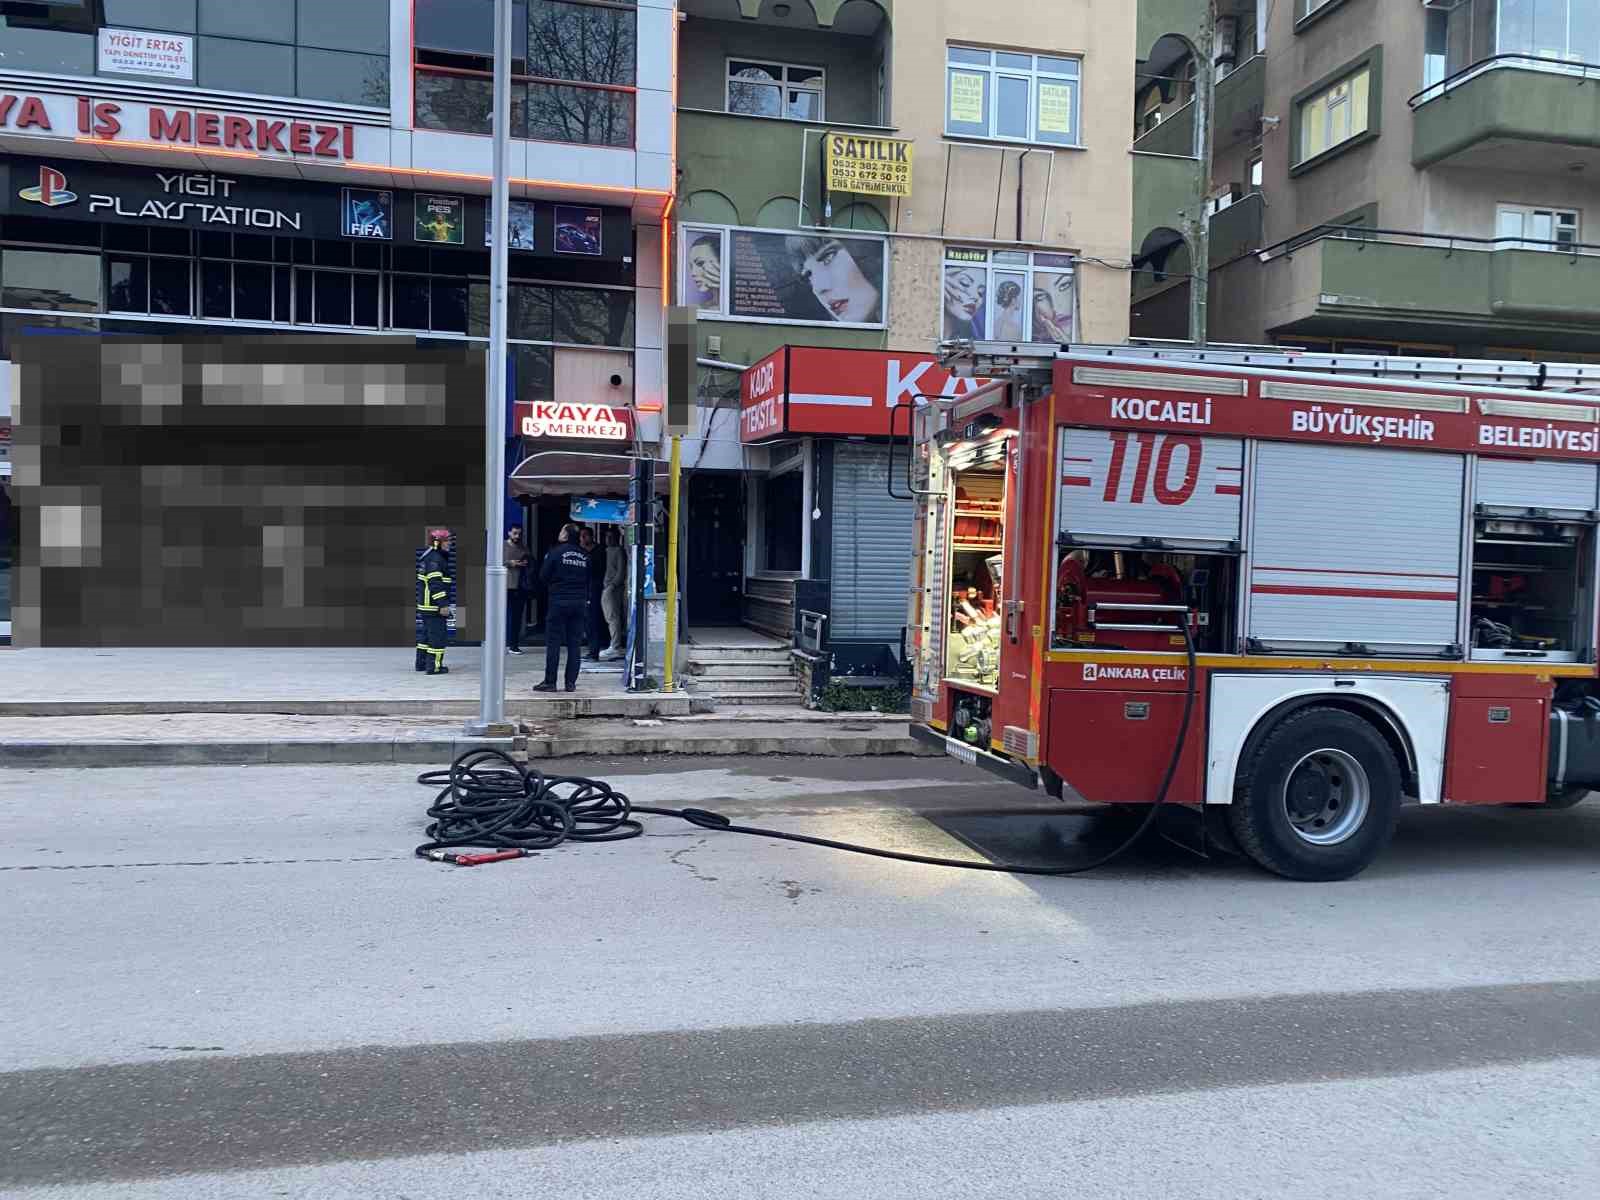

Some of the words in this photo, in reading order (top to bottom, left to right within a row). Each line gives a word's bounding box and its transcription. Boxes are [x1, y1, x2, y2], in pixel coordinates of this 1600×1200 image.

[145, 37, 183, 54] ERTAŞ
[77, 96, 121, 140] İŞ
[149, 108, 354, 159] MERKEZİ
[833, 137, 908, 162] SATILIK
[156, 173, 237, 197] YİĞİT
[89, 194, 301, 229] PLAYSTATION
[351, 222, 384, 237] FIFA
[535, 402, 613, 421] KAYA
[1110, 398, 1212, 425] KOCAELİ
[1291, 406, 1435, 442] BÜYÜKŞEHİR
[1478, 423, 1600, 453] BELEDİYESİ
[1102, 432, 1204, 506] 110
[1098, 667, 1150, 680] ANKARA
[1152, 667, 1186, 683] ÇELİK
